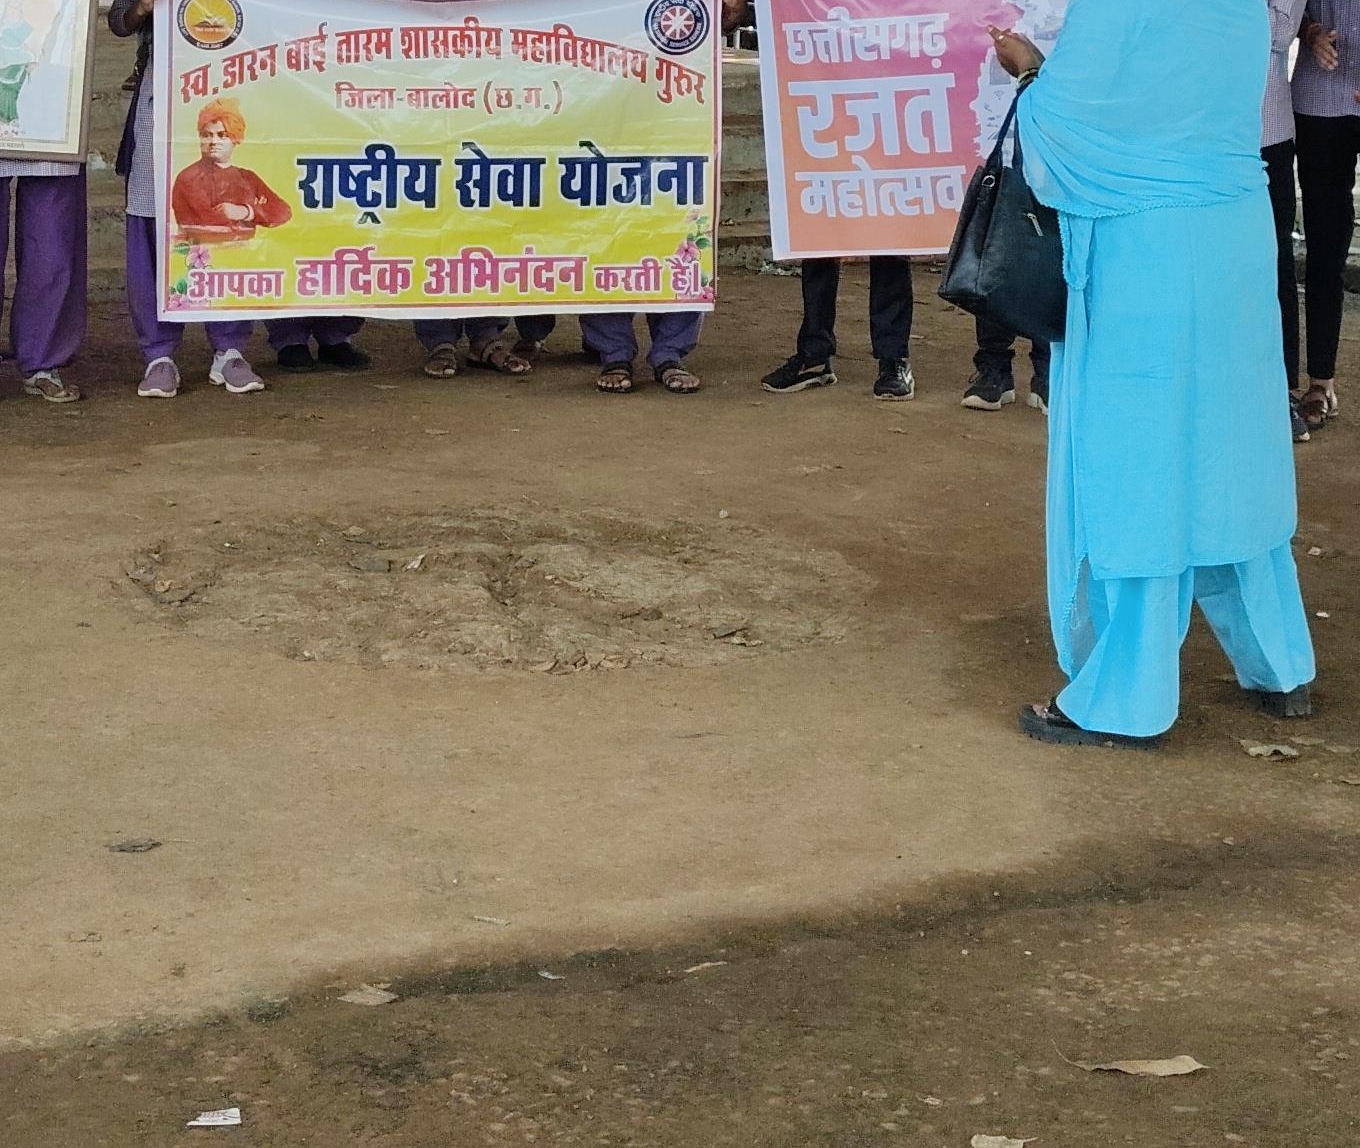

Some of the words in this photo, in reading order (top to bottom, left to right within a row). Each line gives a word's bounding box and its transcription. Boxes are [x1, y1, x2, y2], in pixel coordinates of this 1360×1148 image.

[284, 21, 329, 73] बाई
[334, 27, 393, 66] तारम
[400, 16, 503, 60] शासकीय
[509, 23, 650, 84] महाविद्यालय
[782, 6, 950, 69] छत्तीसगढ़
[483, 80, 563, 114] (छ.ग.)
[788, 73, 956, 160] रजत
[296, 143, 442, 225] राष्ट्रीय
[454, 141, 546, 209] सेवा
[558, 140, 710, 207] योजना
[795, 155, 966, 218] महोत्सव
[189, 270, 285, 298] आपका
[295, 246, 414, 296] हार्दिक
[424, 246, 587, 295] अभिनंदन
[594, 258, 663, 292] करती
